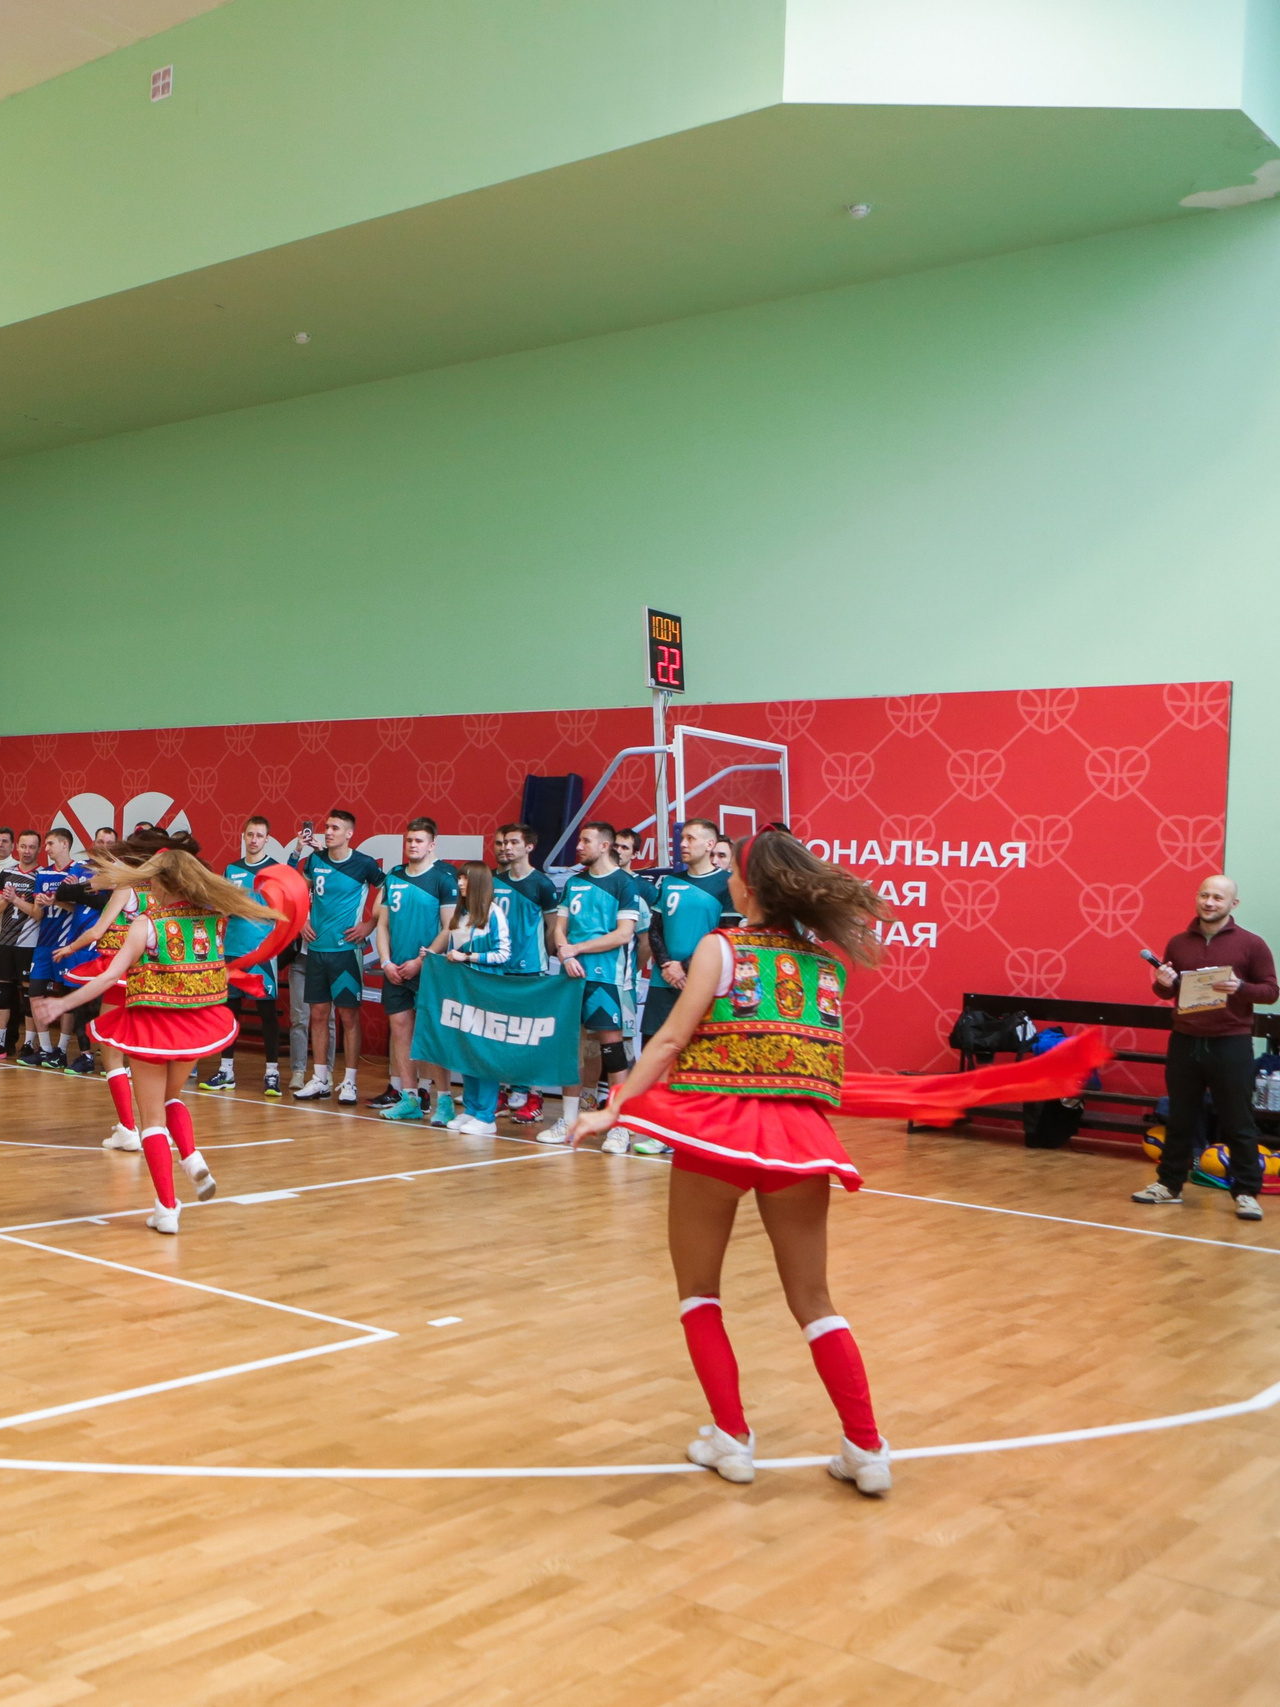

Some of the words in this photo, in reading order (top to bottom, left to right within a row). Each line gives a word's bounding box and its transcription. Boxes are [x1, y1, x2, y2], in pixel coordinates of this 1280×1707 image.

[657, 645, 680, 685] 22
[315, 875, 325, 896] 8
[46, 904, 63, 919] 17
[390, 890, 401, 913] 3
[570, 893, 582, 915] 6
[666, 891, 680, 917] 9
[440, 998, 556, 1046] СИБУР
[612, 1012, 619, 1024] 6
